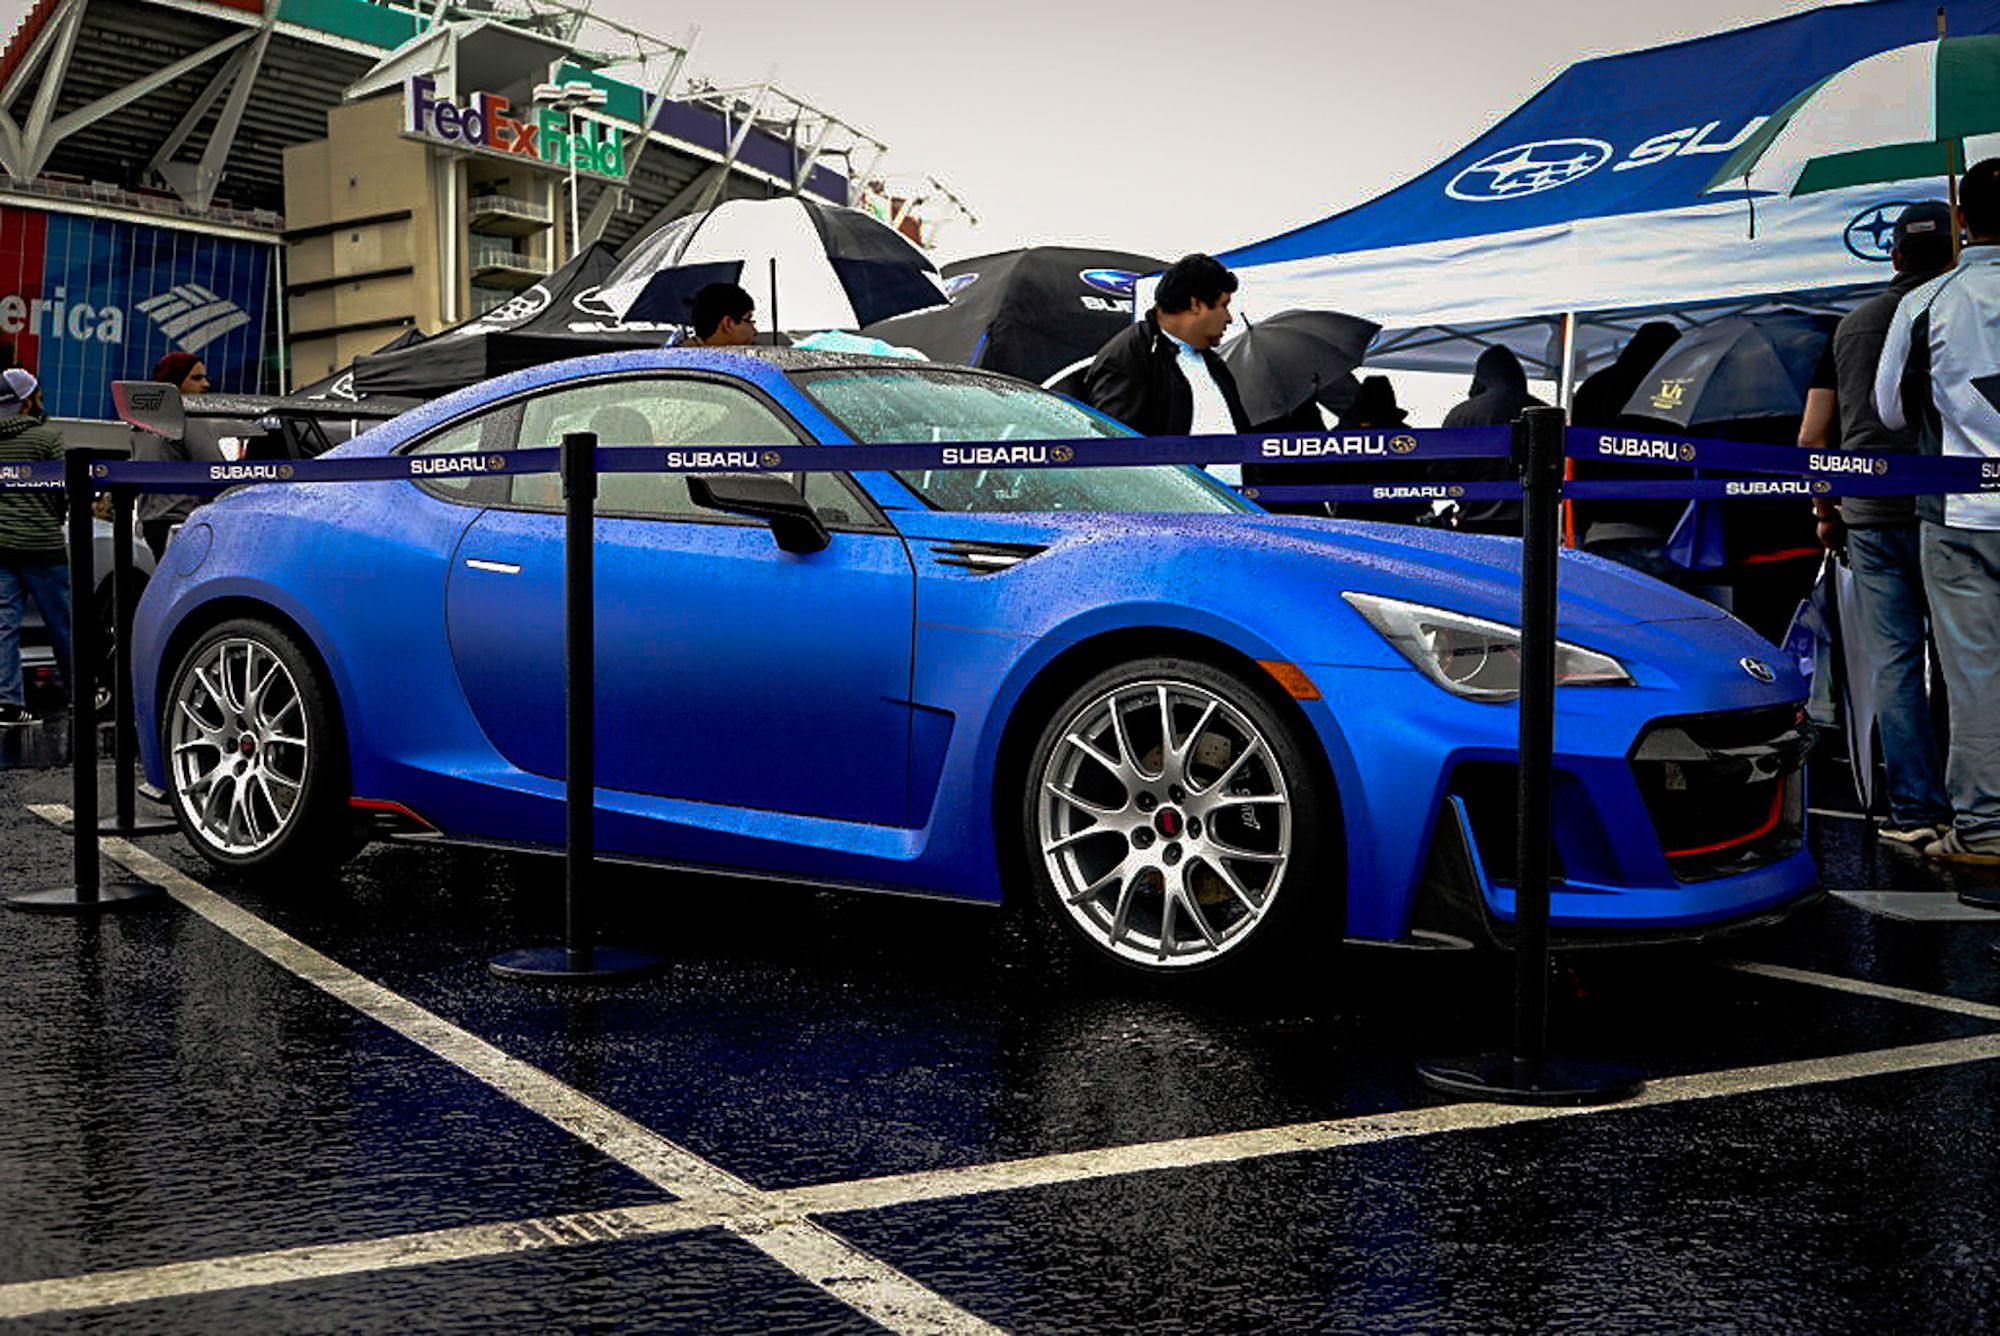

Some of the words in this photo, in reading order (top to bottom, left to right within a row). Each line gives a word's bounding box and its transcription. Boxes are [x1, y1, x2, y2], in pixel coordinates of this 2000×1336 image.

[0, 286, 123, 343] erica
[1262, 435, 1384, 456] SUBARU
[1599, 435, 1677, 459] SUBARU
[667, 452, 757, 468] SUBARU
[942, 446, 1046, 464] SUBARU
[210, 465, 276, 480] SUBARU
[411, 457, 485, 473] SUBARU
[1809, 454, 1873, 474] SUBARU
[1373, 486, 1447, 499] SUBARU
[1725, 481, 1810, 495] SUBARU
